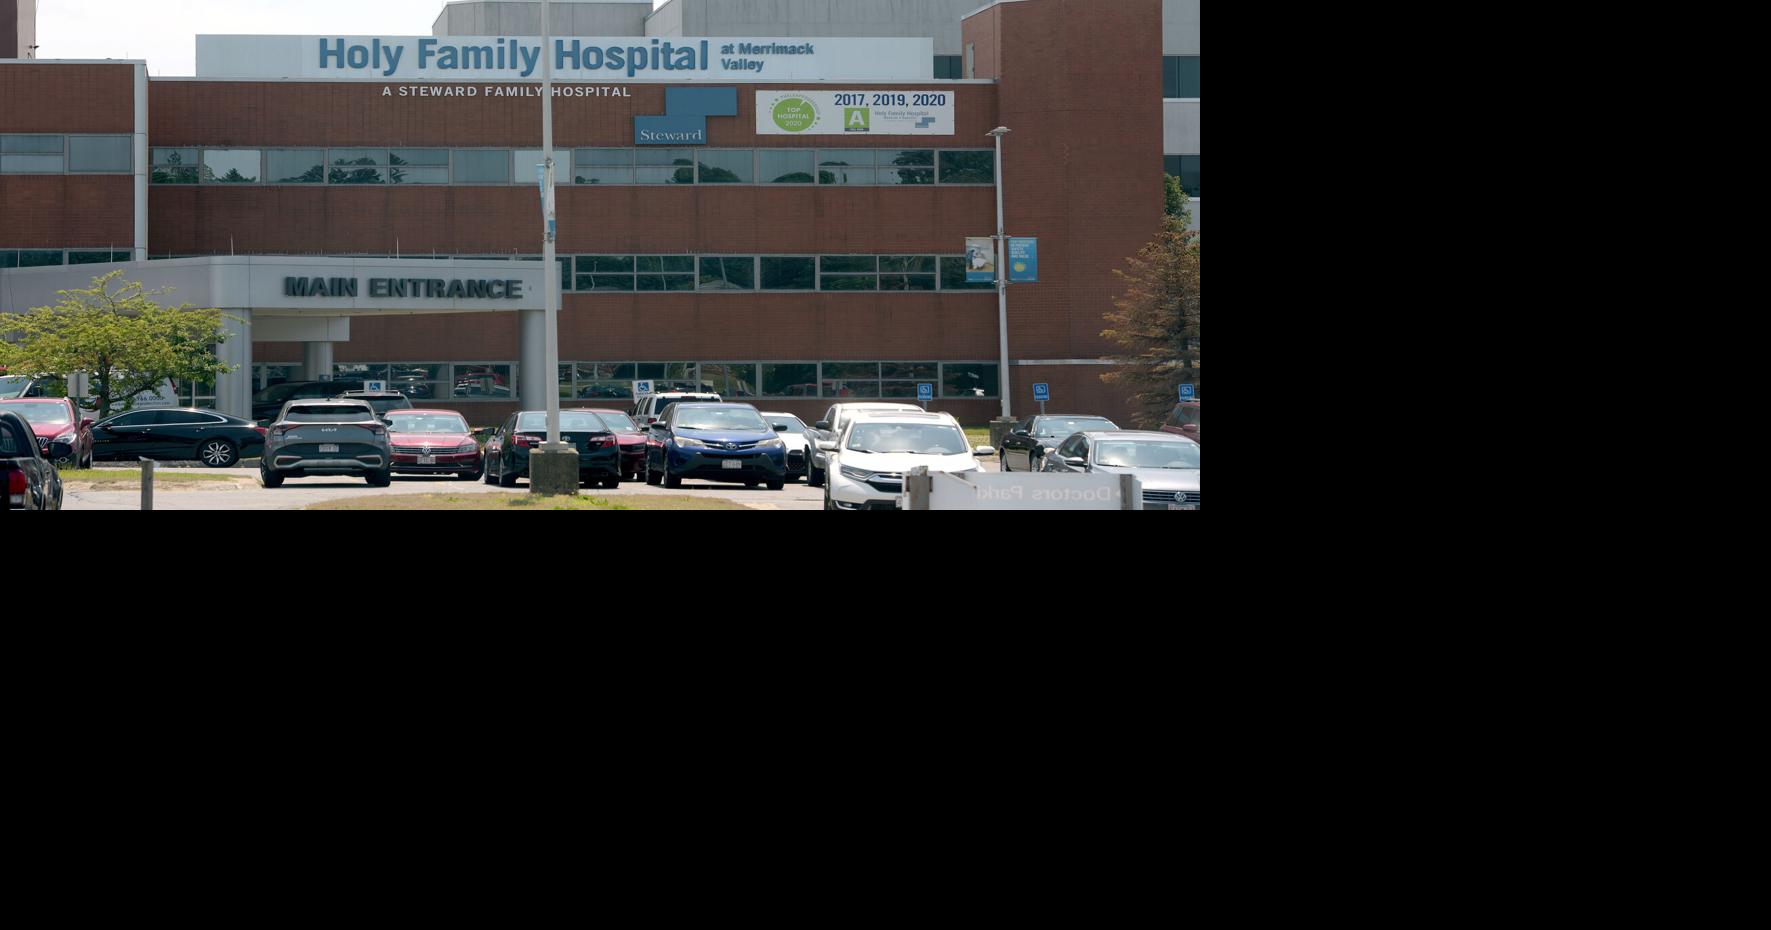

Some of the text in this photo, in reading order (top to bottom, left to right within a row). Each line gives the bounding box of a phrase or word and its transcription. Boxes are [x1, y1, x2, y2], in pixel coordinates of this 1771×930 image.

[720, 42, 815, 56] at Merrimack
[319, 37, 709, 78] Holy Family Hospital
[721, 58, 765, 73] Valley
[382, 86, 632, 98] A STEWARD FAMILY HOSPITAL
[834, 94, 869, 107] 2017,
[873, 94, 909, 107] 2019,
[912, 94, 946, 106] 2020
[848, 110, 865, 126] A
[639, 128, 703, 143] Steward
[285, 276, 524, 299] MAIN ENTRANCE
